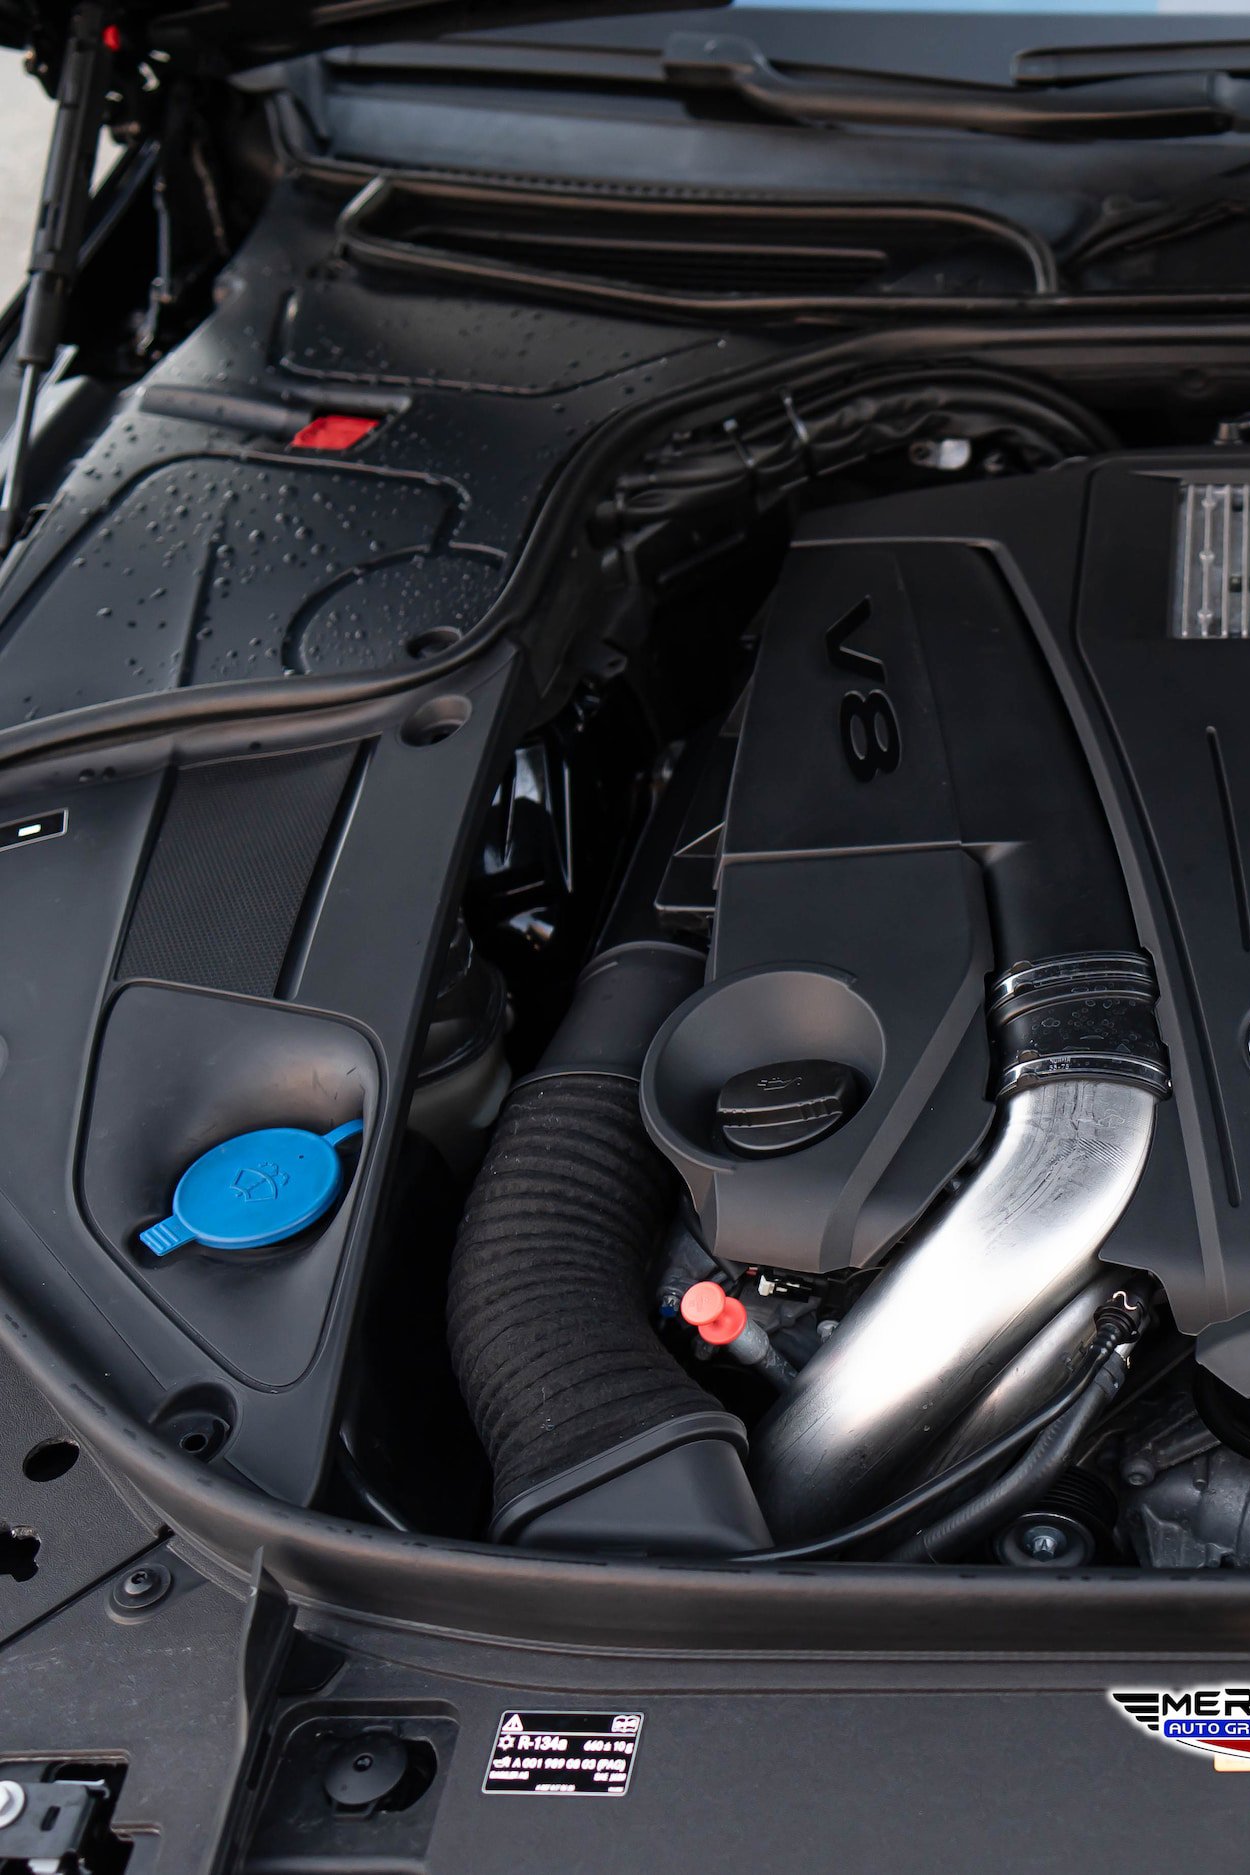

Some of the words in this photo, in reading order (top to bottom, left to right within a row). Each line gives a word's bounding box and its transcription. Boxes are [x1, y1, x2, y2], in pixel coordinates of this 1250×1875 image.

[826, 594, 902, 783] V8
[517, 1735, 568, 1750] R-134a
[511, 1757, 521, 1769] A
